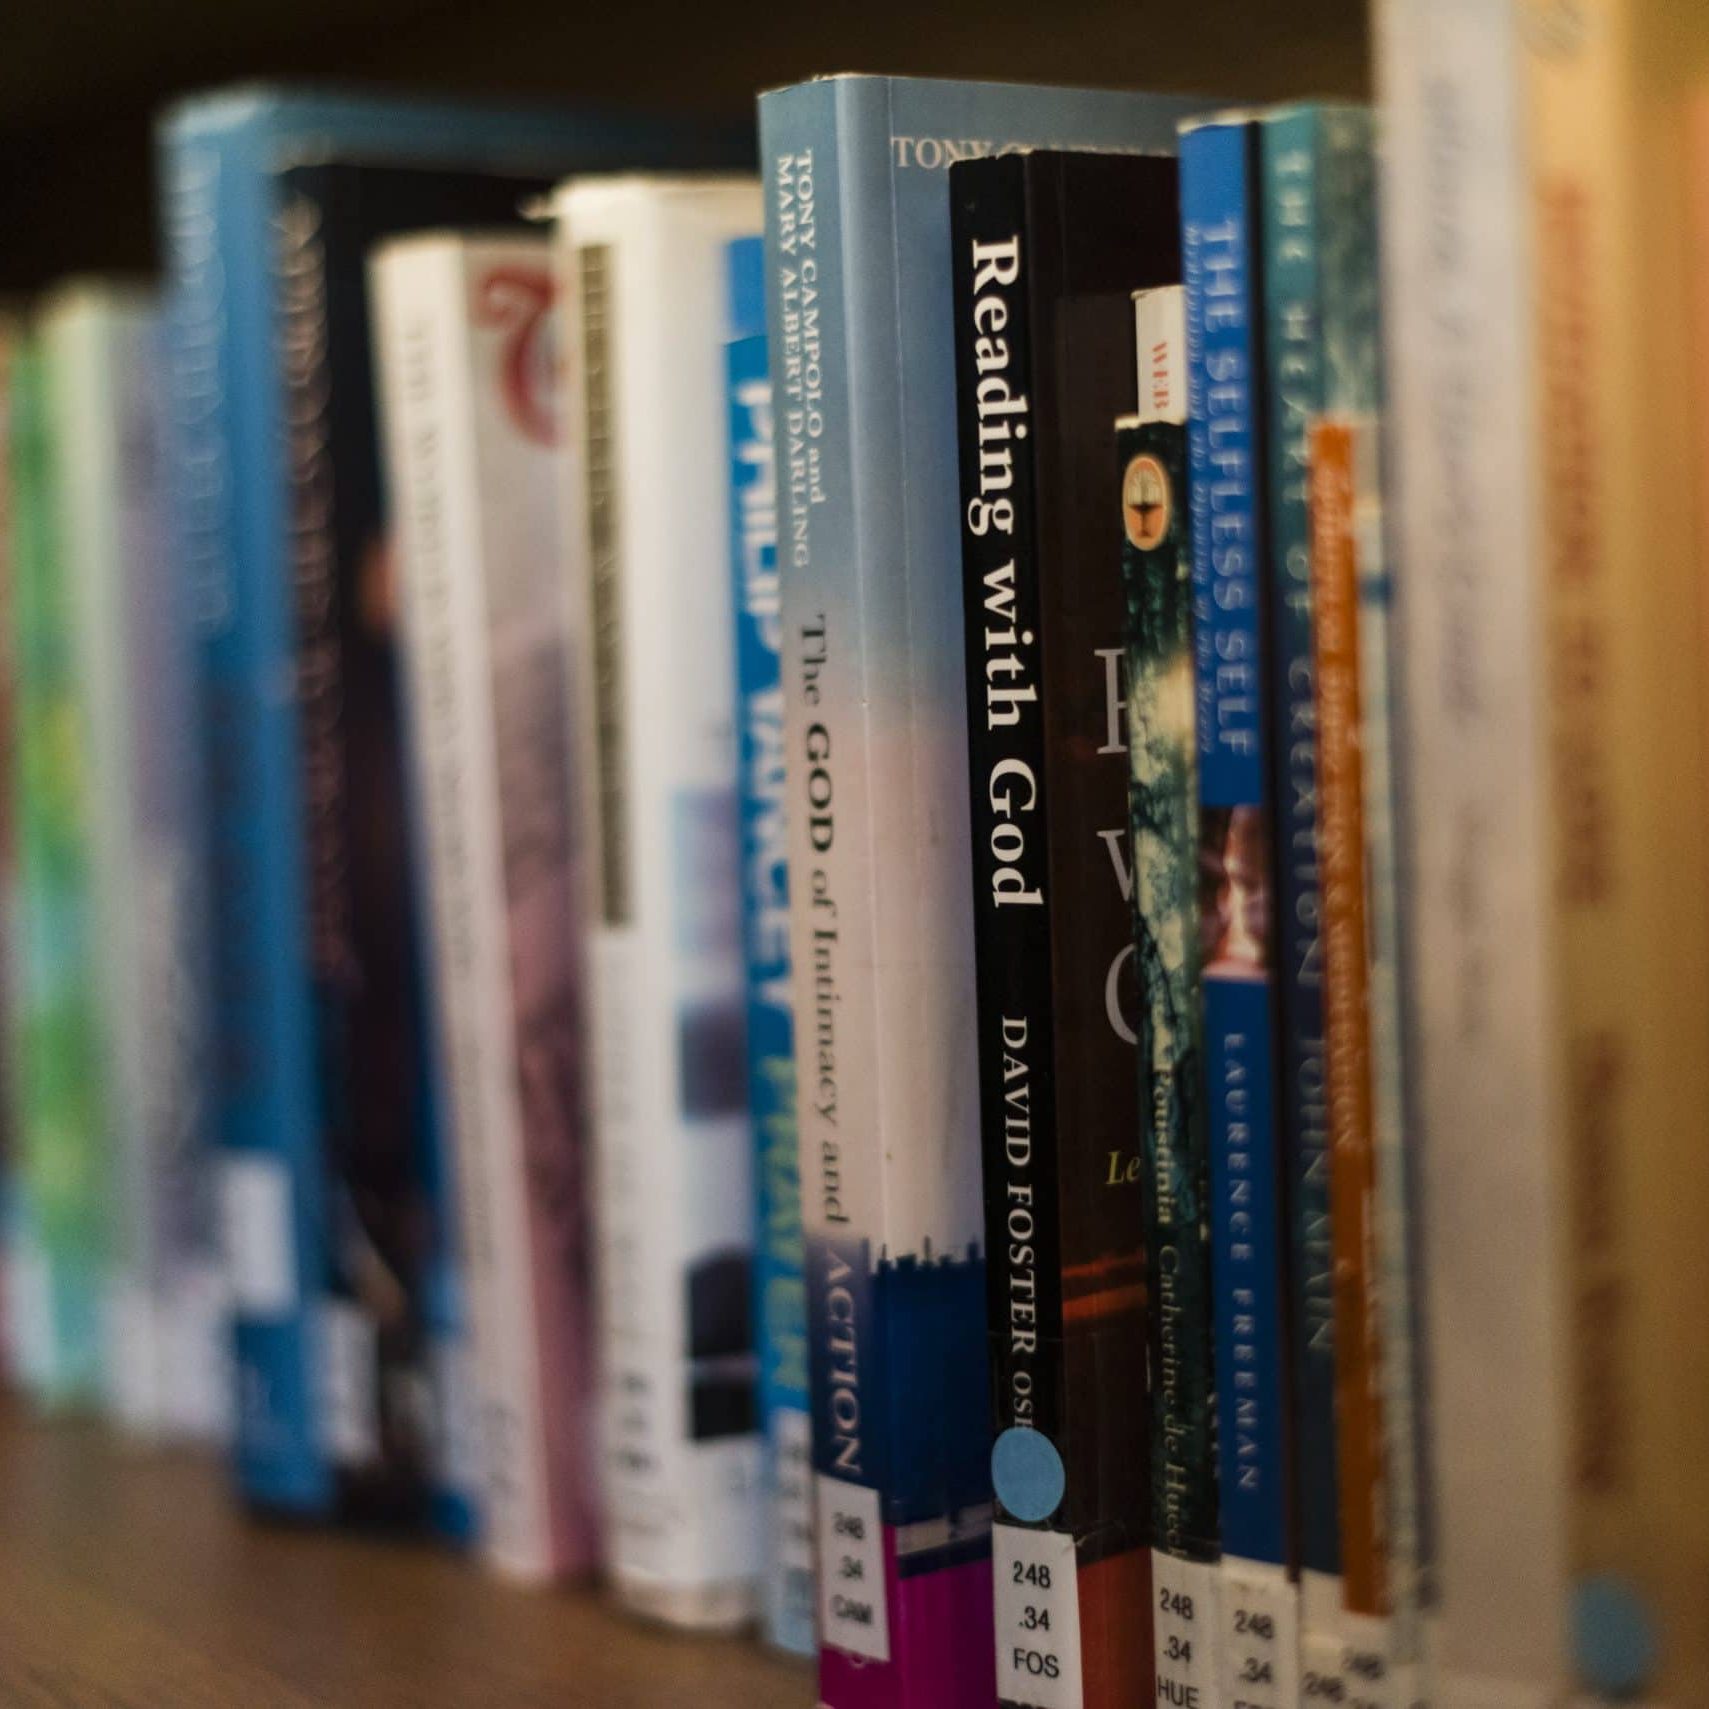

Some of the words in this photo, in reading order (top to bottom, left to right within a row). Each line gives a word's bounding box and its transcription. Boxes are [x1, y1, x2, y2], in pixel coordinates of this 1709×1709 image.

[778, 152, 797, 256] MARY
[797, 146, 816, 249] TONY
[781, 268, 803, 402] ALBERT
[1201, 216, 1240, 334] THE
[802, 259, 823, 438] CAMPOLO
[966, 234, 1027, 538] Reading
[1151, 340, 1169, 411] WEB
[786, 410, 810, 568] DARLING
[808, 447, 827, 504] and
[1205, 350, 1248, 611] SELFLESS
[800, 613, 828, 708] The
[982, 559, 1037, 731] with
[1215, 628, 1252, 756] SELF
[805, 722, 834, 854] GOD
[988, 758, 1043, 908] God
[810, 868, 838, 917] of
[810, 929, 841, 1128] Intimacy
[1001, 1014, 1030, 1167] DAVID
[821, 1139, 851, 1224] and
[1154, 1070, 1176, 1224] Poustinia
[1222, 1032, 1250, 1262] LAURENCE
[1006, 1183, 1036, 1354] FOSTER
[1158, 1244, 1183, 1404] Catherine
[823, 1249, 862, 1476] ACTION
[1229, 1288, 1257, 1490] FREEMAN
[1164, 1413, 1186, 1451] de
[1013, 1560, 1051, 1588] 248
[1019, 1606, 1050, 1631] .34
[1160, 1586, 1194, 1621] 248
[1234, 1609, 1275, 1640] 248
[1013, 1648, 1060, 1678] FOS
[1157, 1675, 1200, 1709] HUE
[1163, 1634, 1192, 1664] .34
